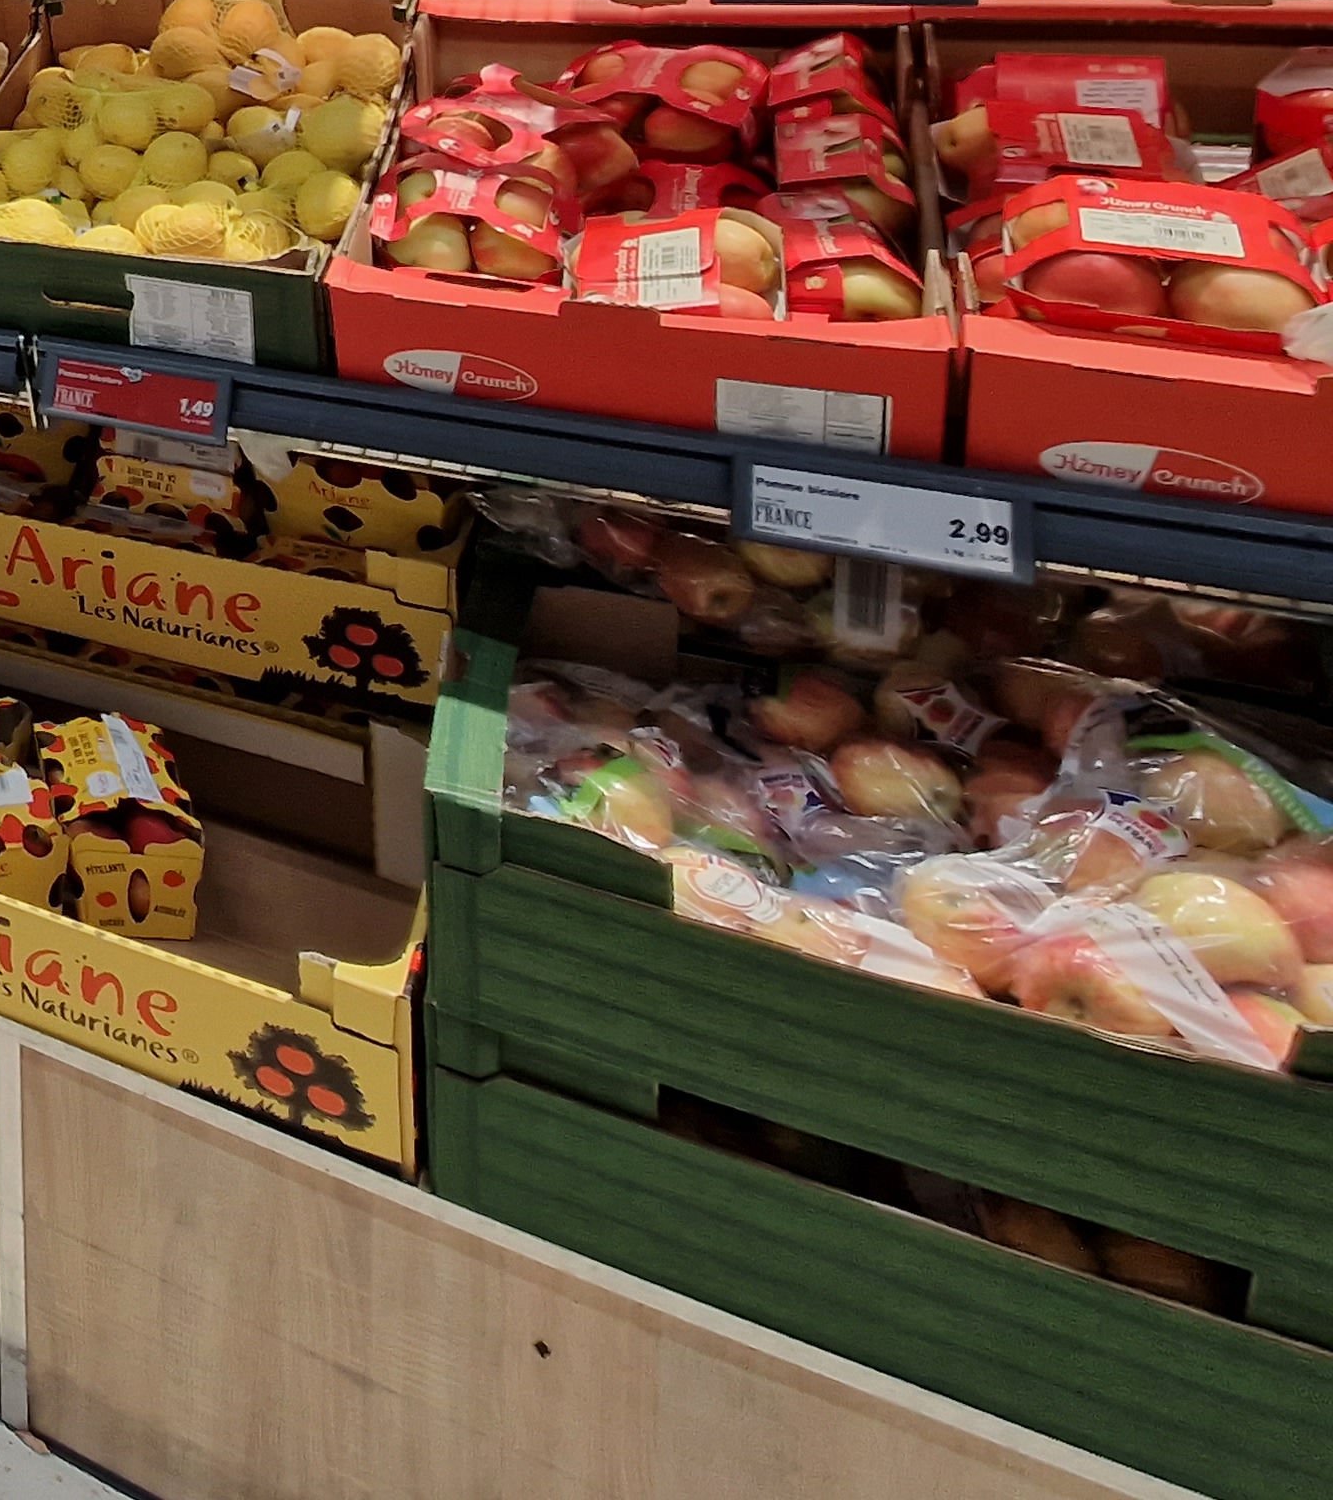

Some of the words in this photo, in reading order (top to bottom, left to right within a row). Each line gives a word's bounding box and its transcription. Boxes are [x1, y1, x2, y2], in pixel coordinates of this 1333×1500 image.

[1099, 195, 1151, 211] Honey
[1152, 200, 1209, 217] Crunch
[393, 358, 454, 384] Honey
[461, 370, 528, 393] Crunch
[54, 386, 95, 409] FRANCE
[179, 397, 214, 418] 1,49
[1053, 452, 1146, 487] Honey
[1152, 465, 1248, 497] Crunch
[755, 476, 804, 494] Pomme
[807, 484, 860, 502] bicolore
[754, 502, 813, 531] FRANCE
[948, 518, 1009, 546] 2,99
[5, 524, 262, 634] Ariane
[76, 593, 116, 622] Les
